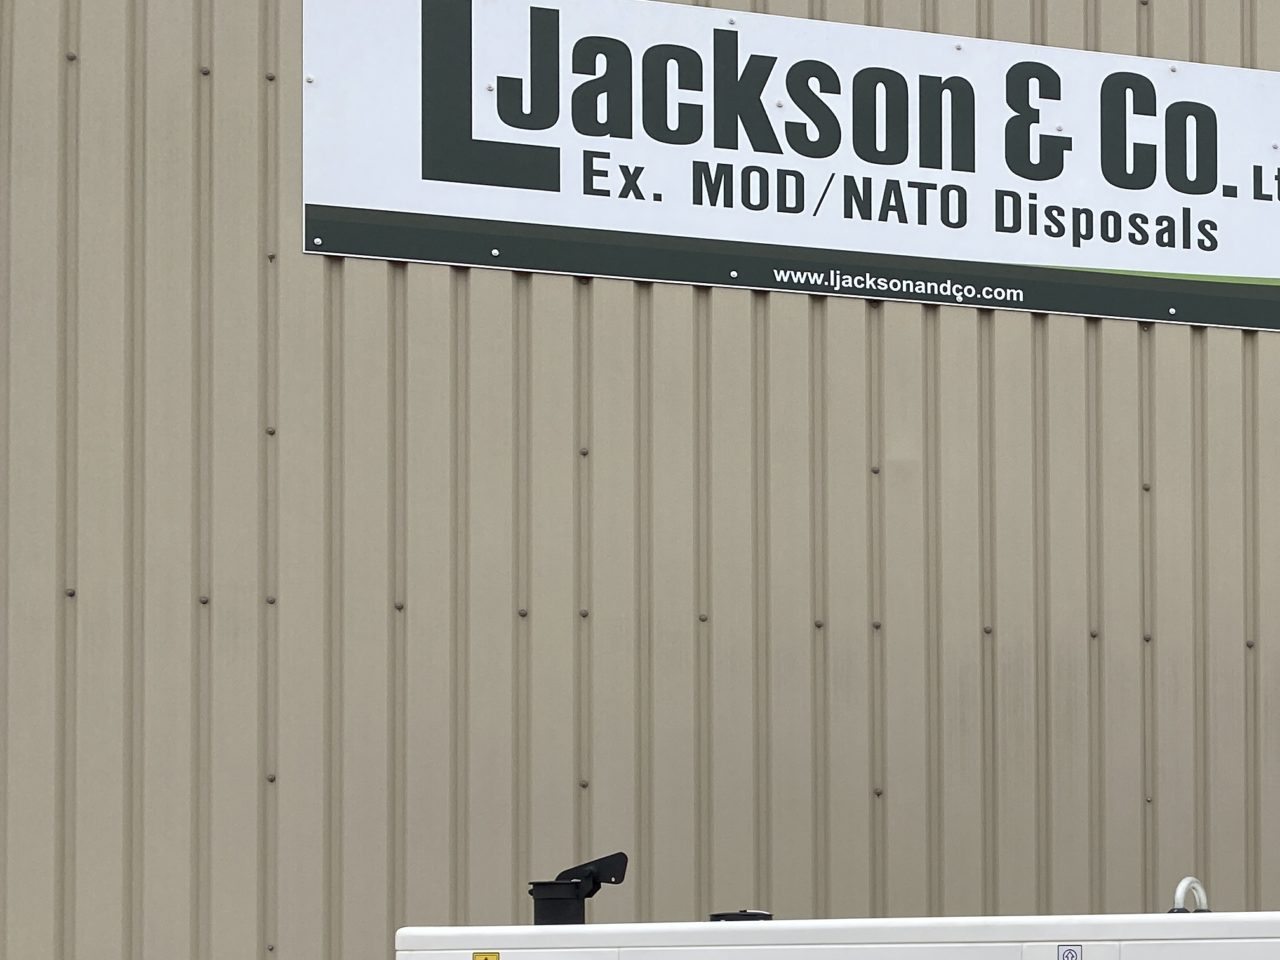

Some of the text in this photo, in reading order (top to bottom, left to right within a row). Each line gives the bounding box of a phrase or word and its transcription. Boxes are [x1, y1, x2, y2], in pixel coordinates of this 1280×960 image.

[1004, 60, 1073, 182] &
[1099, 71, 1239, 199] Co.
[582, 149, 1220, 253] Ex. MOD/NATO Disposals
[773, 268, 1024, 303] www.ljacksonandco.com
